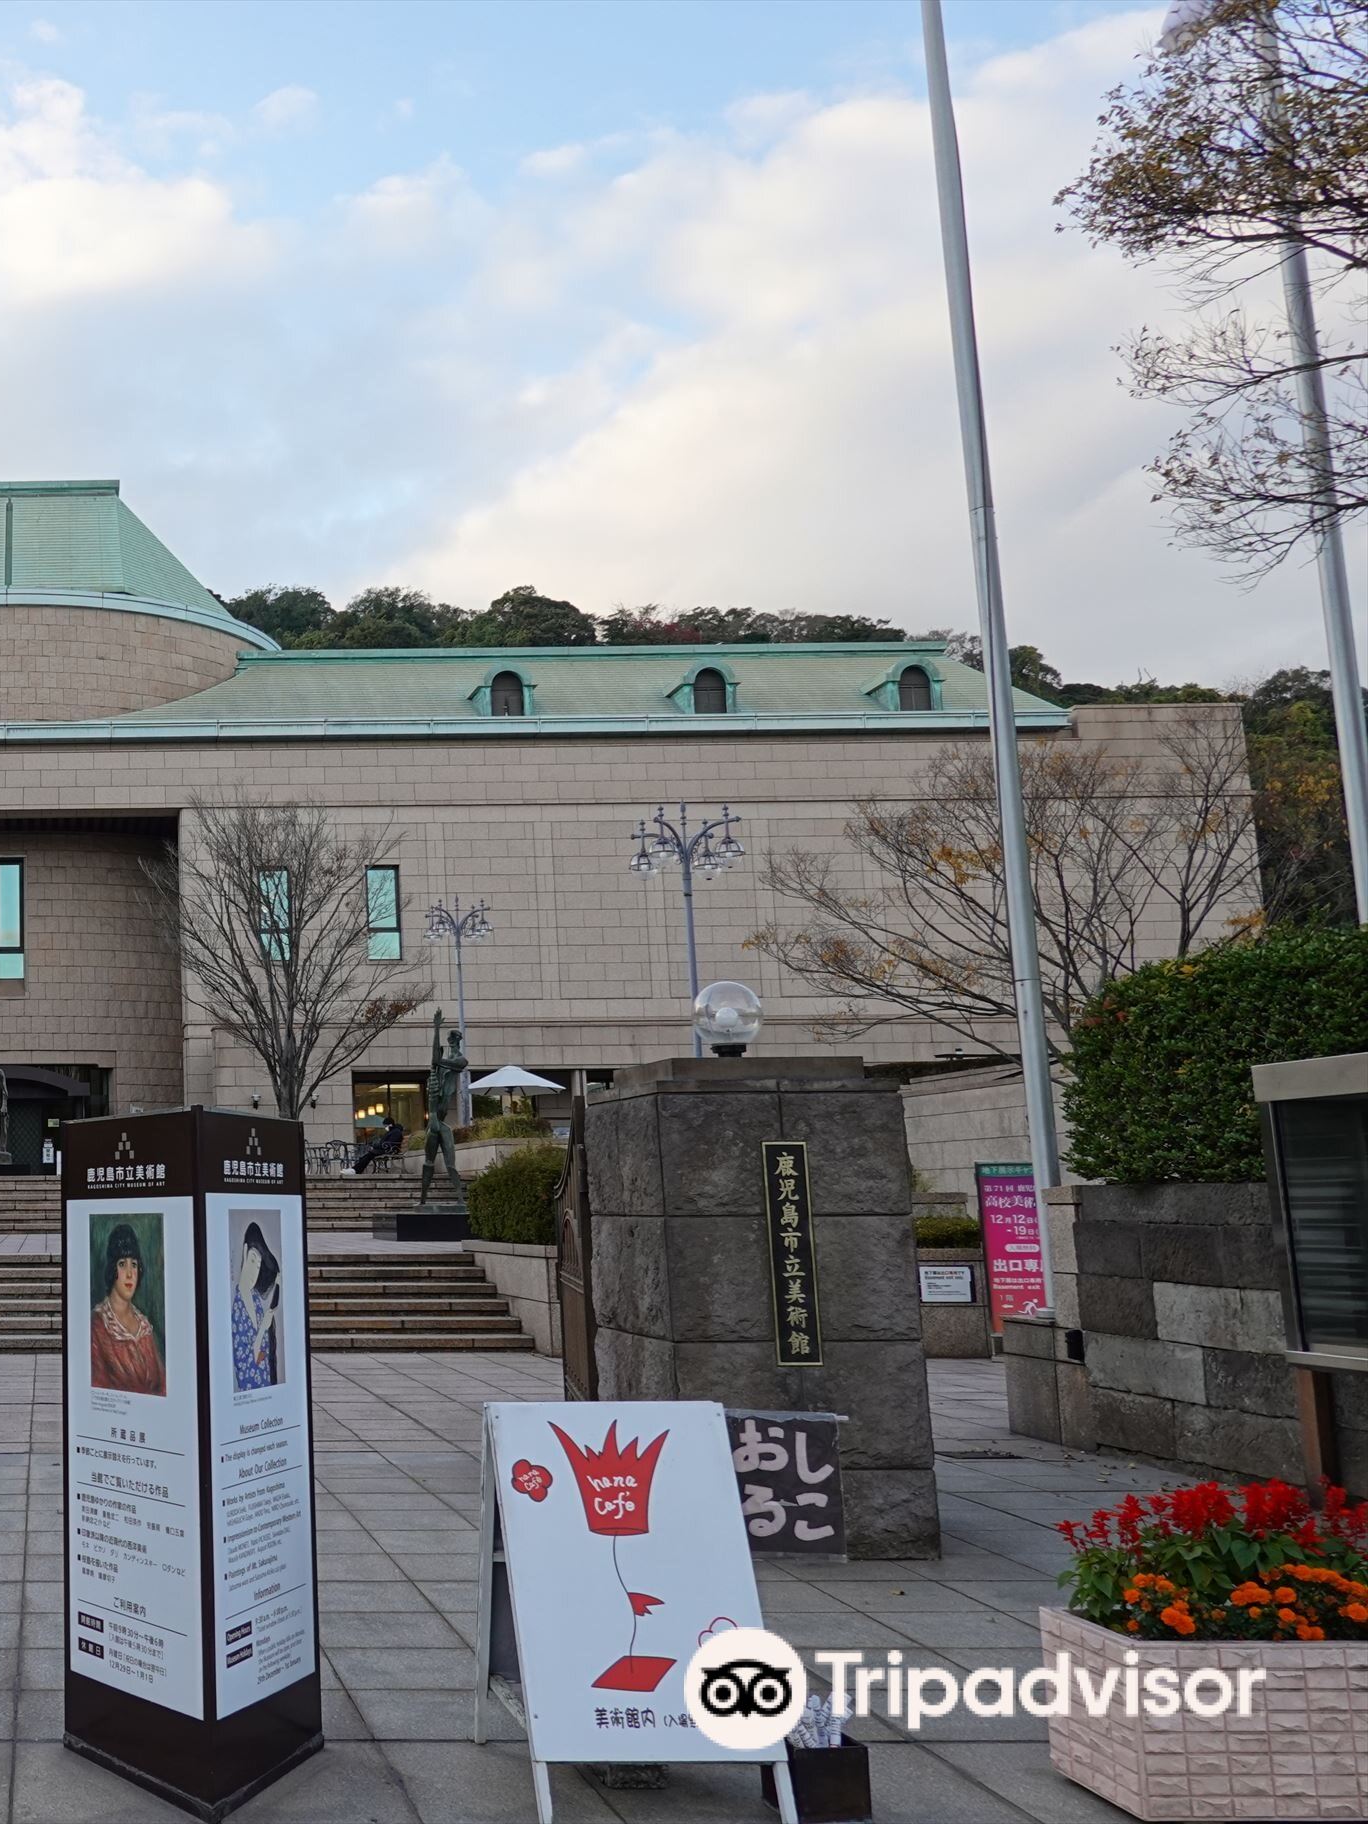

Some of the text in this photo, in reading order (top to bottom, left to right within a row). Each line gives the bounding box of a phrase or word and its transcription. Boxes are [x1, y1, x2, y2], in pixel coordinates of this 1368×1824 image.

[87, 1163, 166, 1183] 鹿児島市立美術館
[223, 1160, 284, 1177] 鹿児島市立美術館
[774, 1152, 811, 1355] 鹿児島市立美術館
[993, 1259, 1043, 1272] 出口専
[111, 1427, 146, 1443] 所蔵品展
[239, 1417, 284, 1434] Museum Collection
[238, 1457, 287, 1479] About Our Collection
[91, 1471, 169, 1498] 当館でご覧いただける作品
[587, 1473, 638, 1490] hana
[253, 1582, 281, 1600] Information
[113, 1596, 146, 1617] ご利用案内
[594, 1707, 655, 1729] 美術館内
